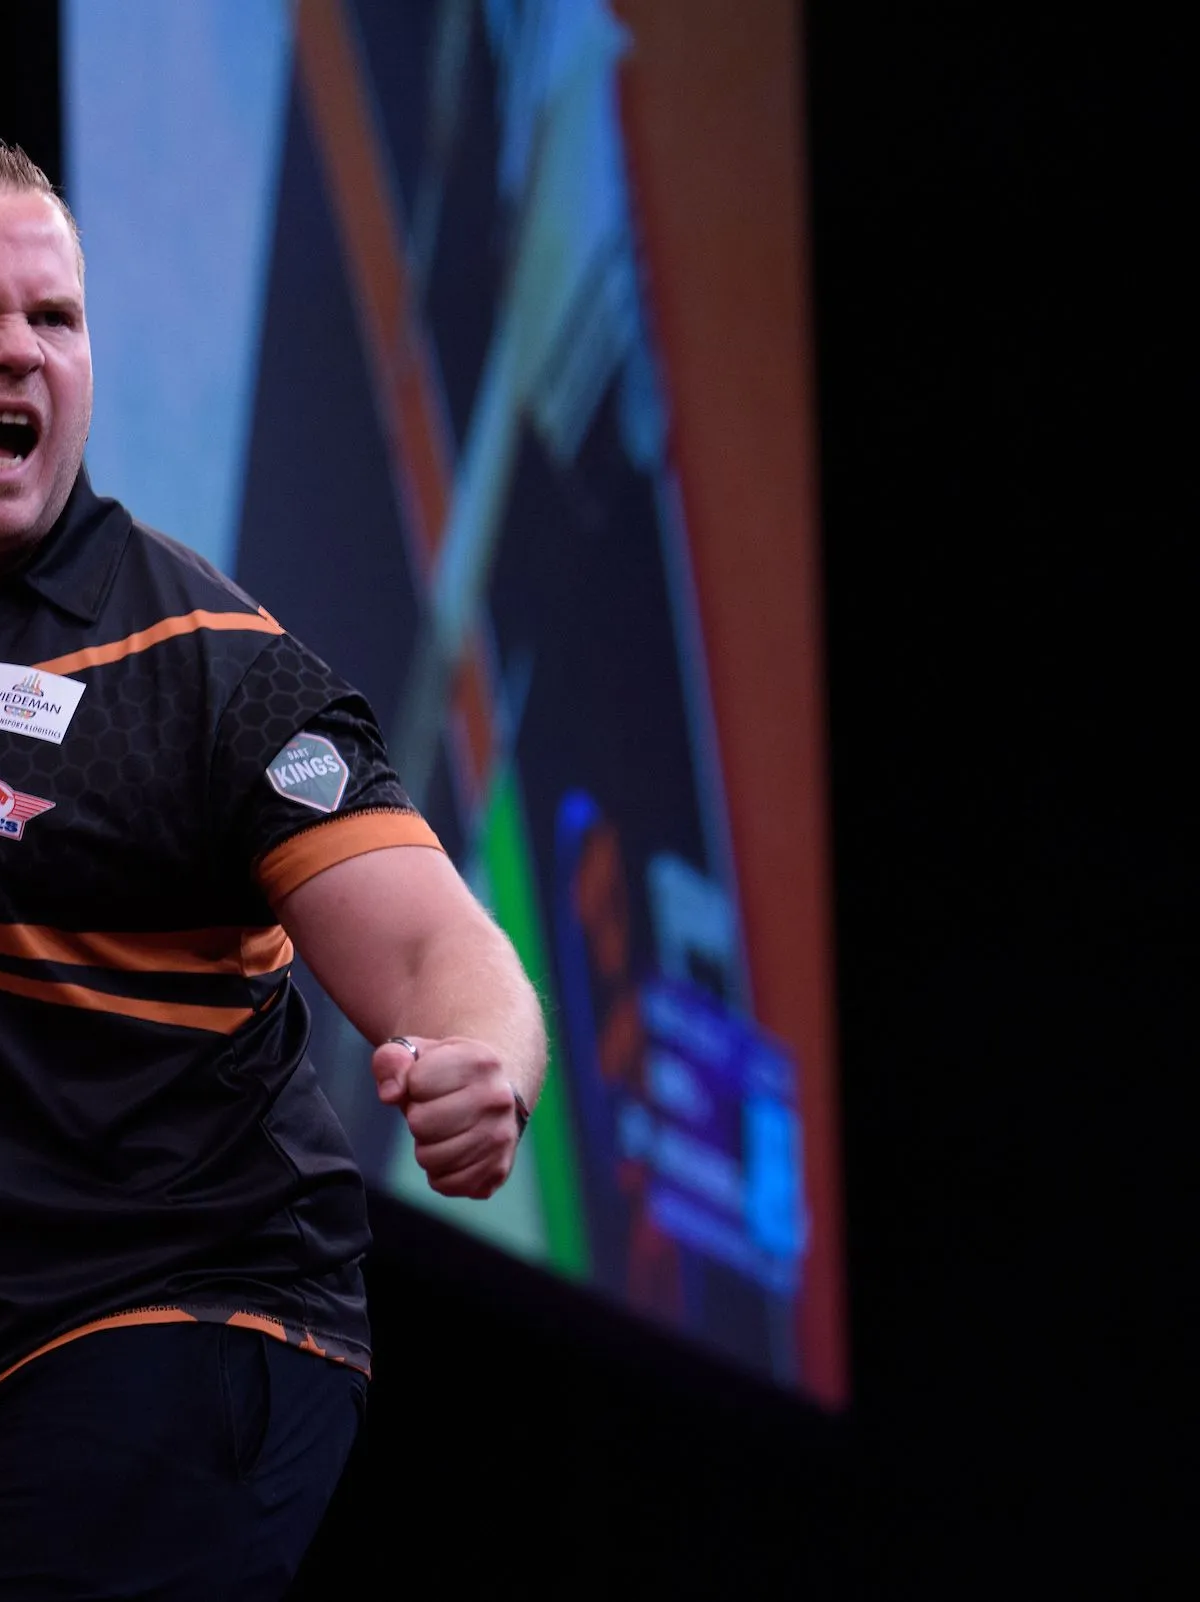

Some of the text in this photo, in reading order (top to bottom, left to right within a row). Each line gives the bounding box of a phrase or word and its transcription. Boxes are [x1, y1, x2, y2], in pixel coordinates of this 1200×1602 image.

[29, 726, 61, 738] LOGISTICS
[287, 747, 310, 760] DART
[274, 754, 340, 788] KINGS
